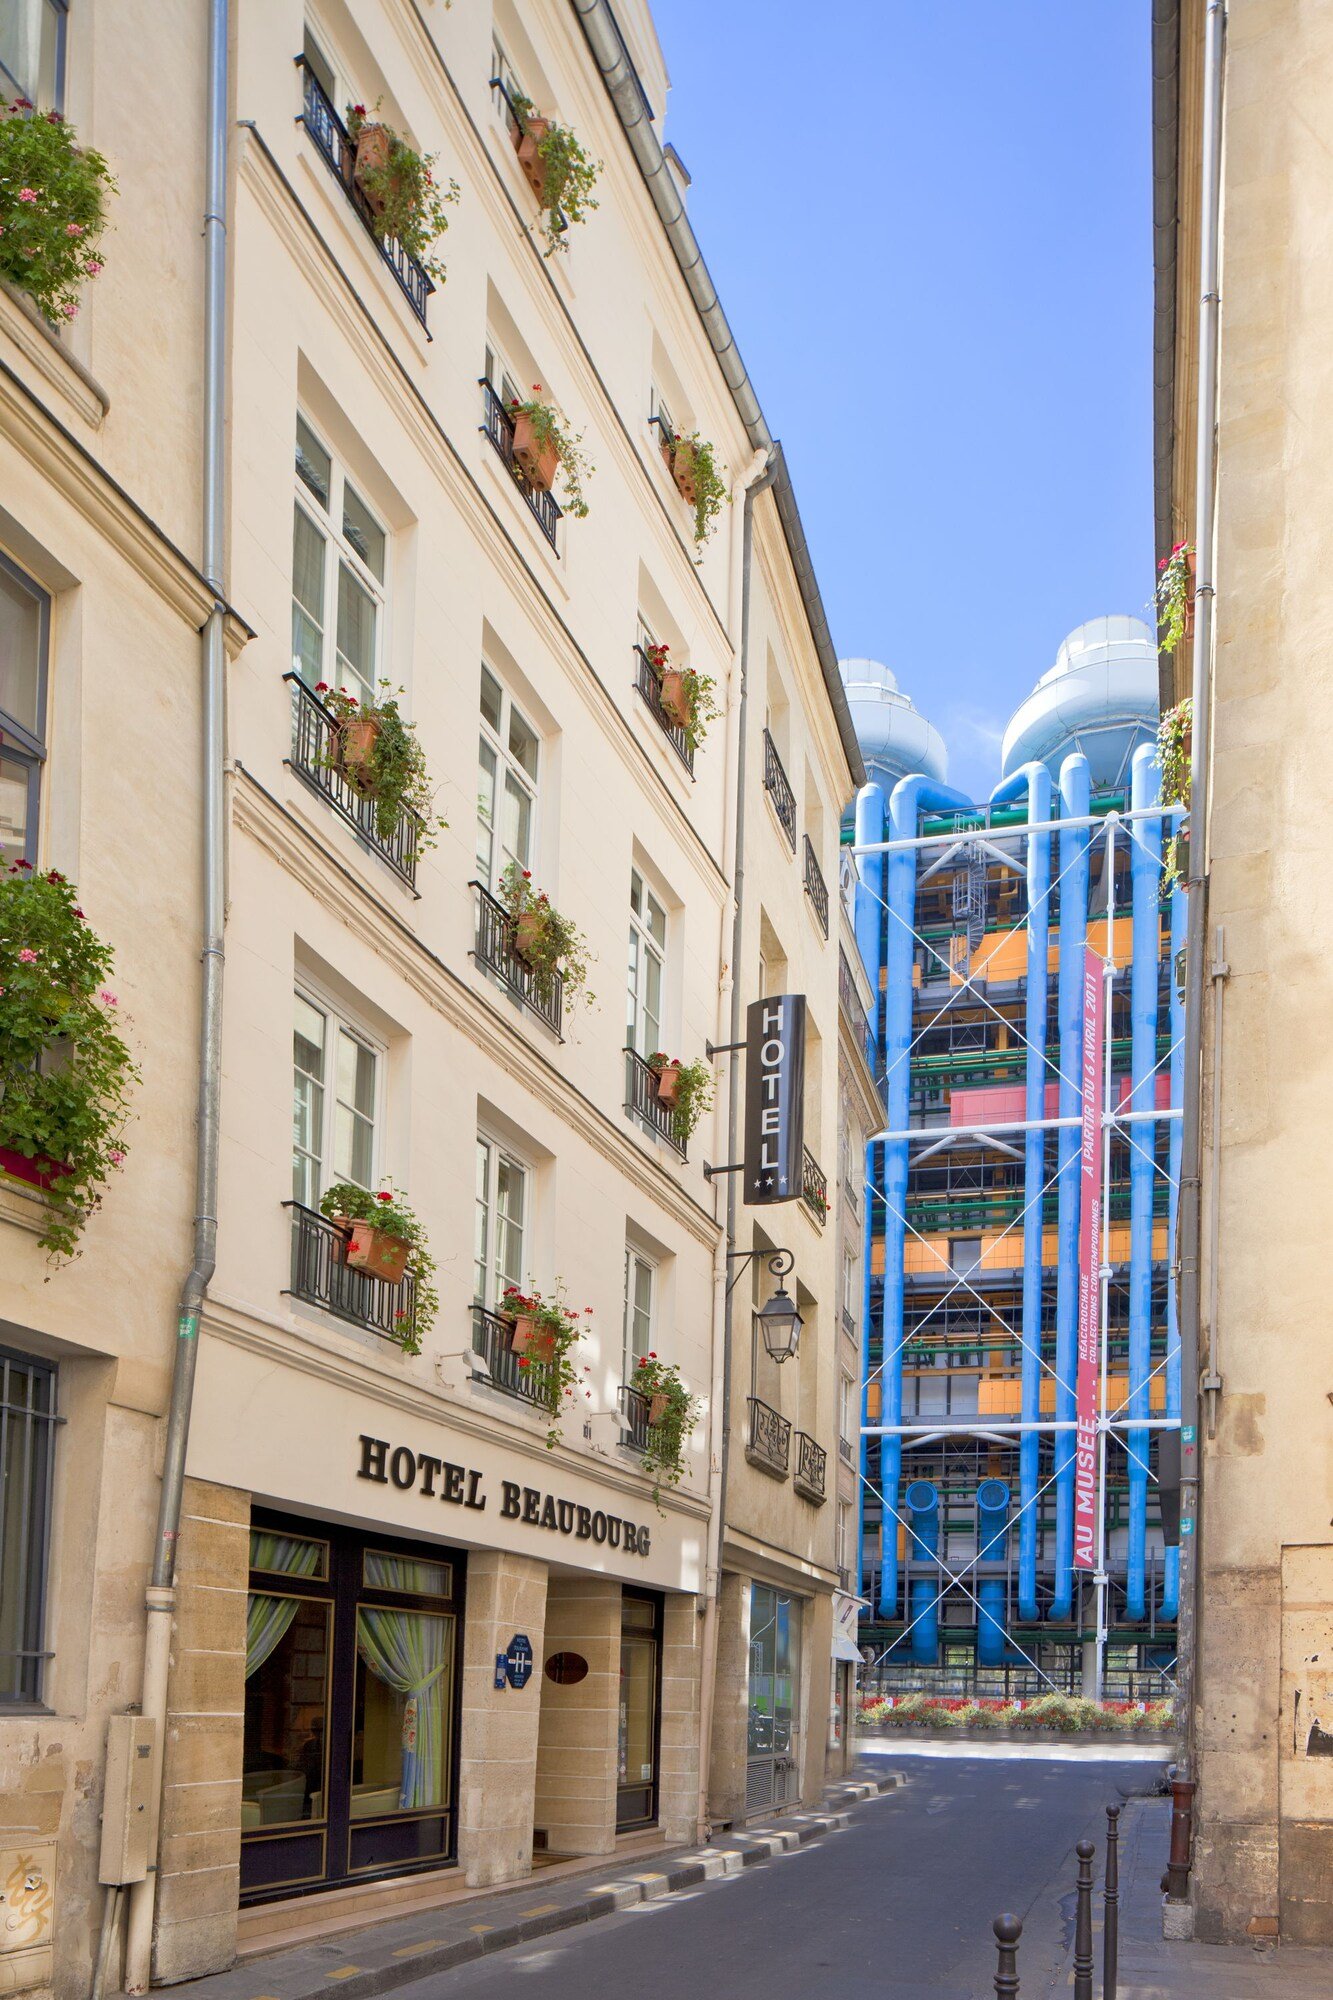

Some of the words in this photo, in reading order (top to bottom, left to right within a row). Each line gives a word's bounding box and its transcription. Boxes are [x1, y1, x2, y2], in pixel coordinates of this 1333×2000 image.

[1086, 972, 1097, 1013] 2011
[1084, 1017, 1096, 1063] AVRIL
[760, 1004, 785, 1170] HOTEL
[1084, 1079, 1095, 1102] DU
[1085, 1066, 1095, 1076] 6
[1083, 1106, 1095, 1162] PARTIR
[1081, 1166, 1093, 1178] À
[1090, 1199, 1099, 1292] CONTEMPORAINES
[1079, 1273, 1089, 1361] RÉACCROCHAGE
[1089, 1295, 1098, 1364] COLLECTIONS
[357, 1434, 487, 1511] HOTEL
[500, 1480, 652, 1556] BEAUBOURG
[1076, 1525, 1093, 1563] AU
[515, 1652, 525, 1673] H
